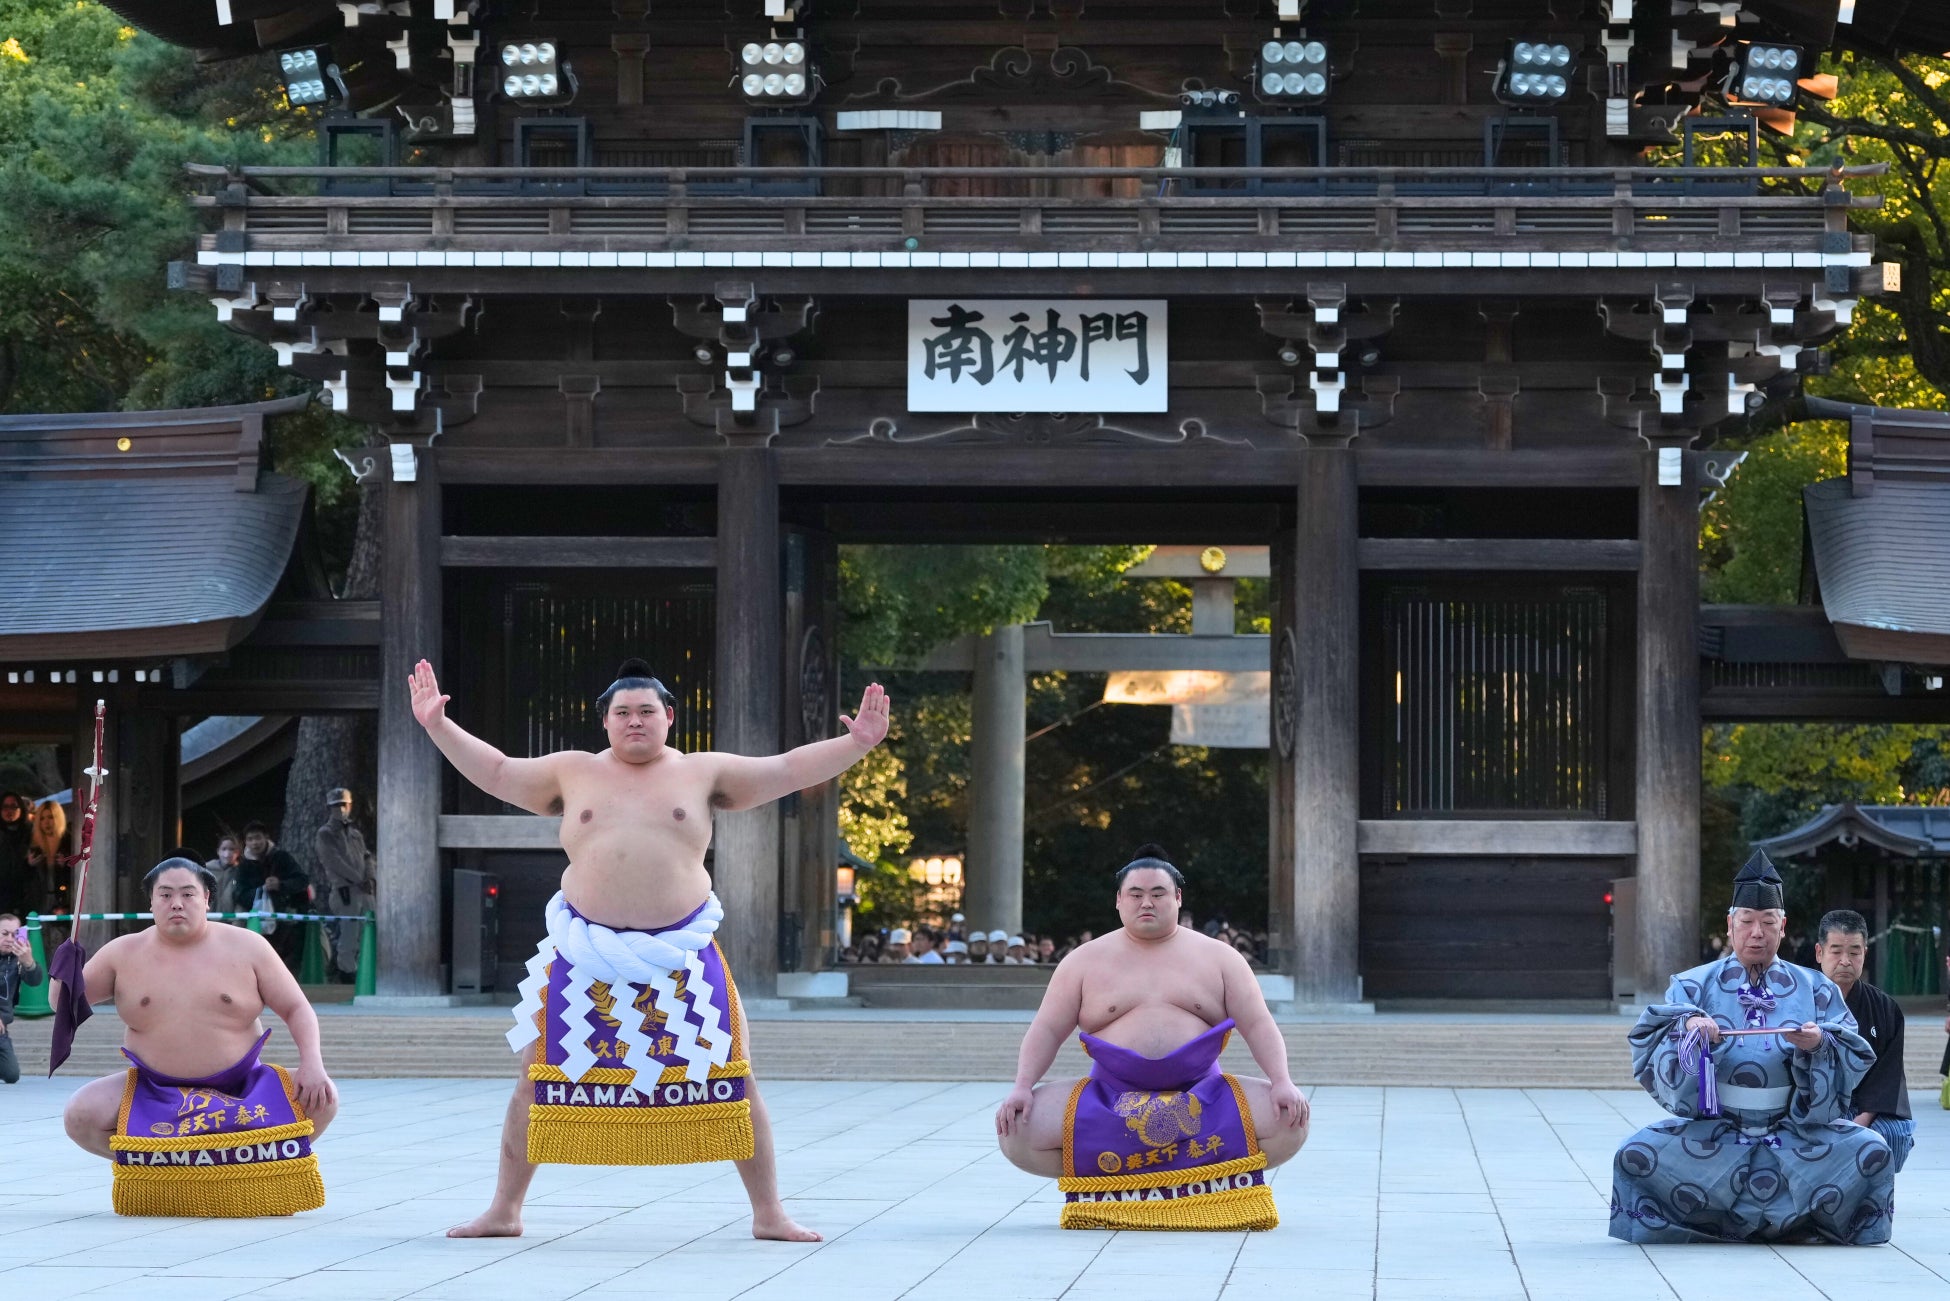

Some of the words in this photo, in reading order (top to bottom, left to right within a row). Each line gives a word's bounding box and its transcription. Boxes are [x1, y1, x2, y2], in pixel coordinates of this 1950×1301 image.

[922, 304, 1149, 386] 南神門
[547, 1080, 734, 1106] HAMATOMO
[126, 1139, 301, 1167] HAMATOMO
[1078, 1172, 1255, 1203] HAMATOMO
